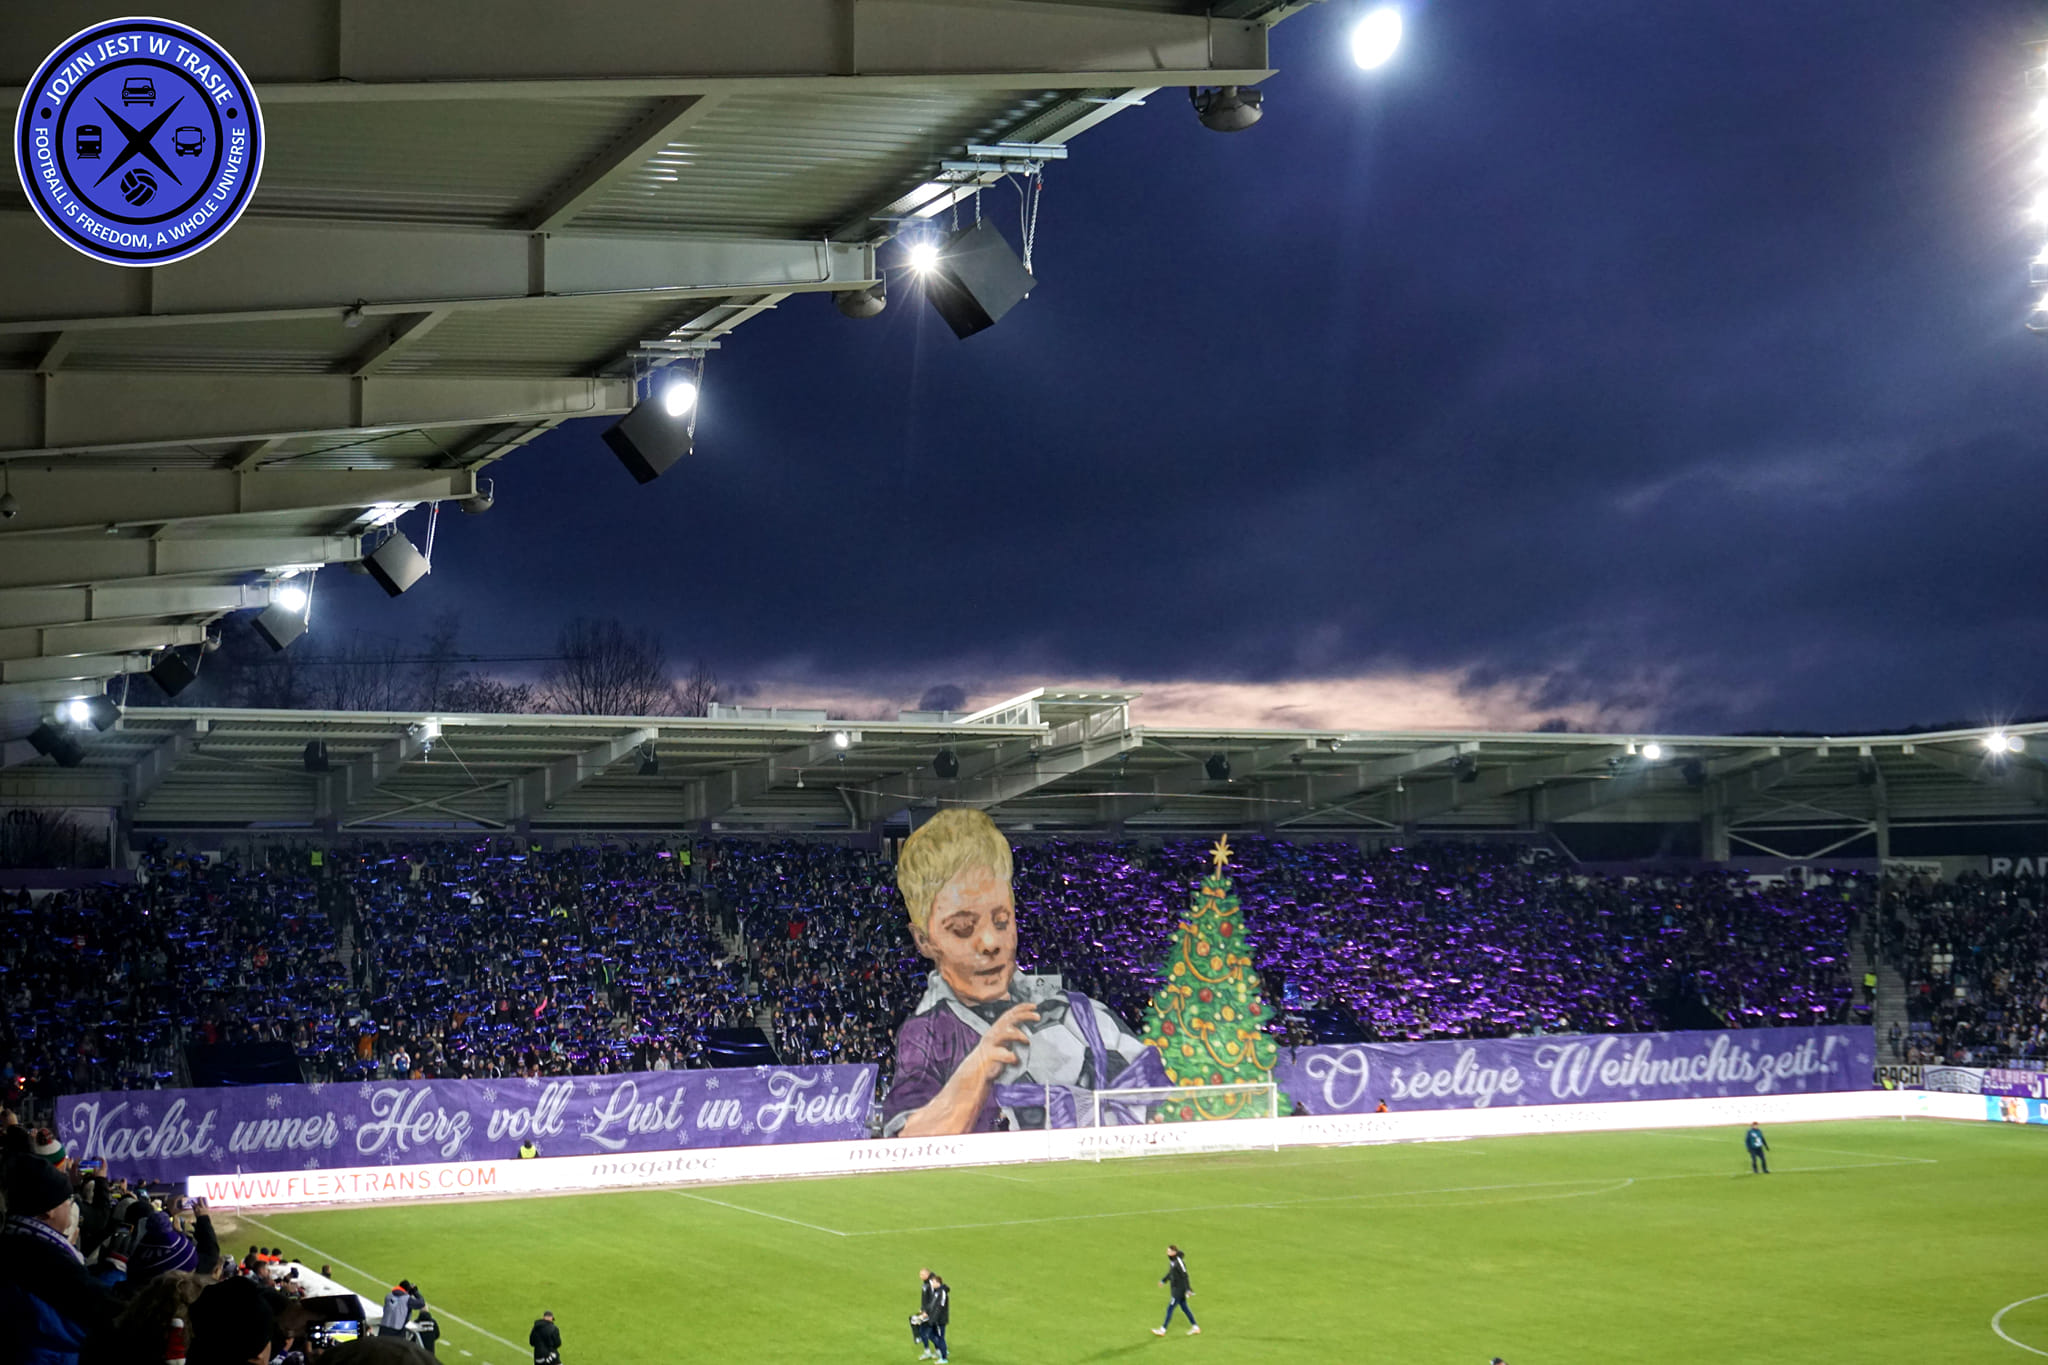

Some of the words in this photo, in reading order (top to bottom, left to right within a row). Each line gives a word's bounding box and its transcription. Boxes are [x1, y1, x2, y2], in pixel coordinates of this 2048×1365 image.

[1306, 1049, 1370, 1109] O
[1391, 1047, 1525, 1108] seelige
[1533, 1034, 1840, 1099] Weihnachtszeit!
[228, 1112, 339, 1152] unner
[356, 1087, 472, 1158] Herz
[487, 1079, 576, 1142] voll
[581, 1080, 685, 1150] Lust
[697, 1098, 743, 1131] un
[756, 1068, 872, 1133] Freid
[591, 1155, 718, 1177] mogatec
[849, 1143, 965, 1162] mogatec
